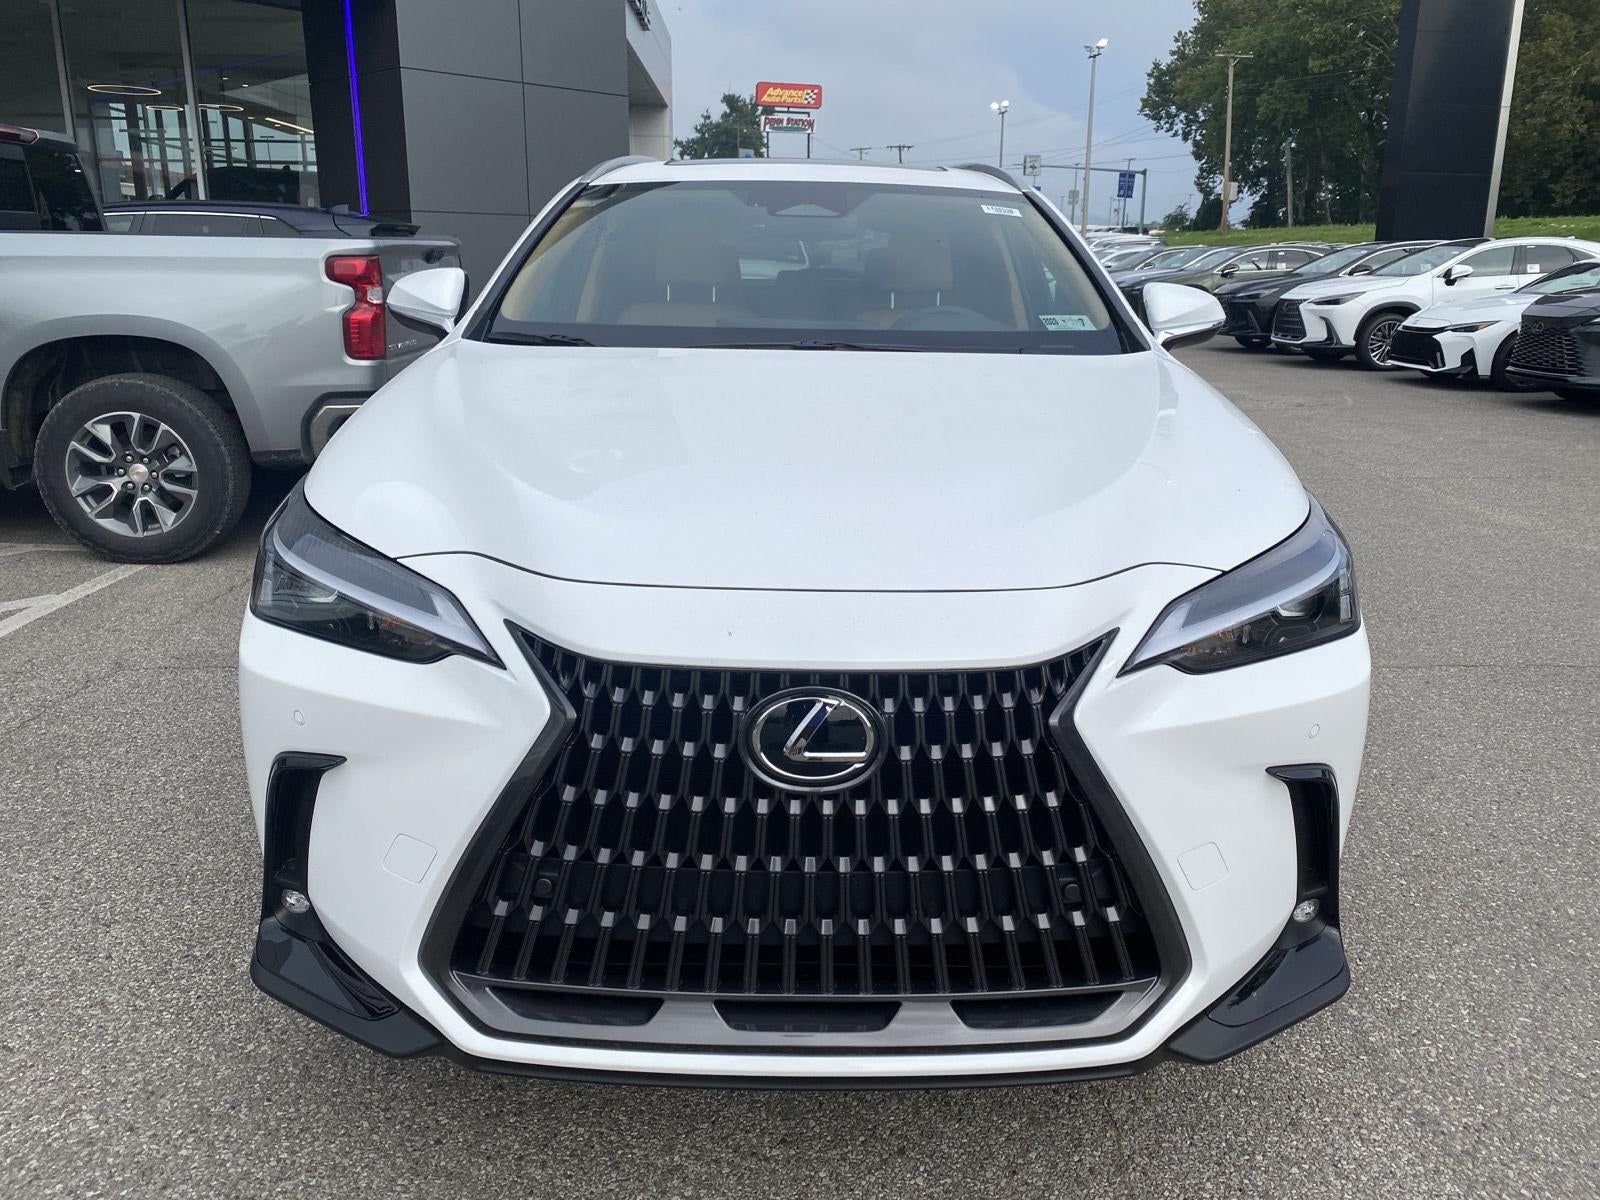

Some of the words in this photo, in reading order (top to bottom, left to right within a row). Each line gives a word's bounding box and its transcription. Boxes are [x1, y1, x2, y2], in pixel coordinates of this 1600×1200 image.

[767, 87, 804, 97] Advance
[780, 95, 805, 104] Parts
[786, 117, 815, 133] STATION
